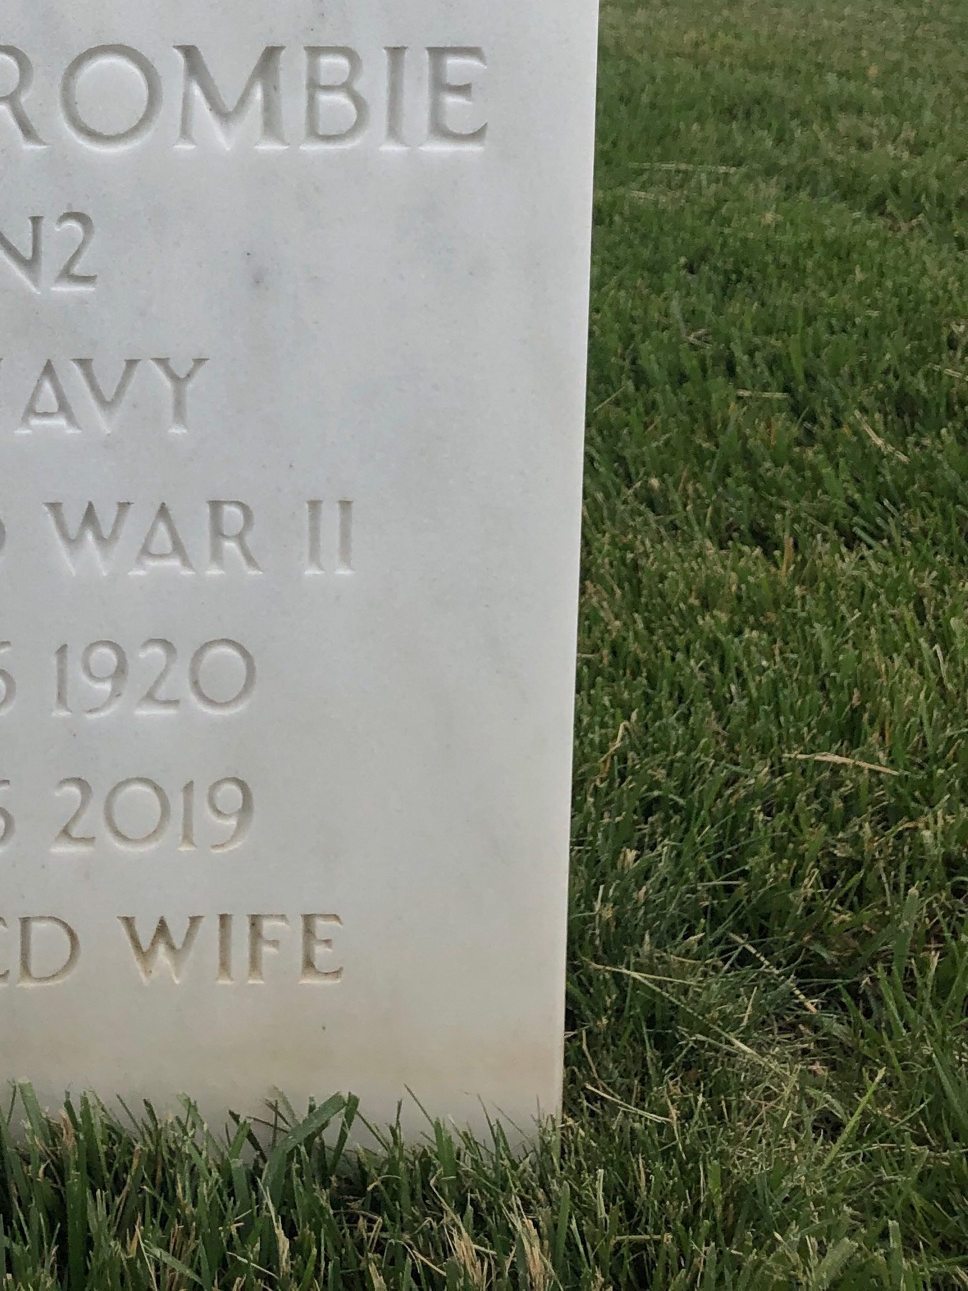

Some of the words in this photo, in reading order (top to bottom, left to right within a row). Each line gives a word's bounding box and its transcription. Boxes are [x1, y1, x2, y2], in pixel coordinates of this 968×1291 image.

[42, 500, 264, 577] WAR
[304, 499, 355, 576] II
[51, 638, 257, 717] 1920
[50, 776, 255, 854] 2019
[117, 913, 345, 987] WIFE
